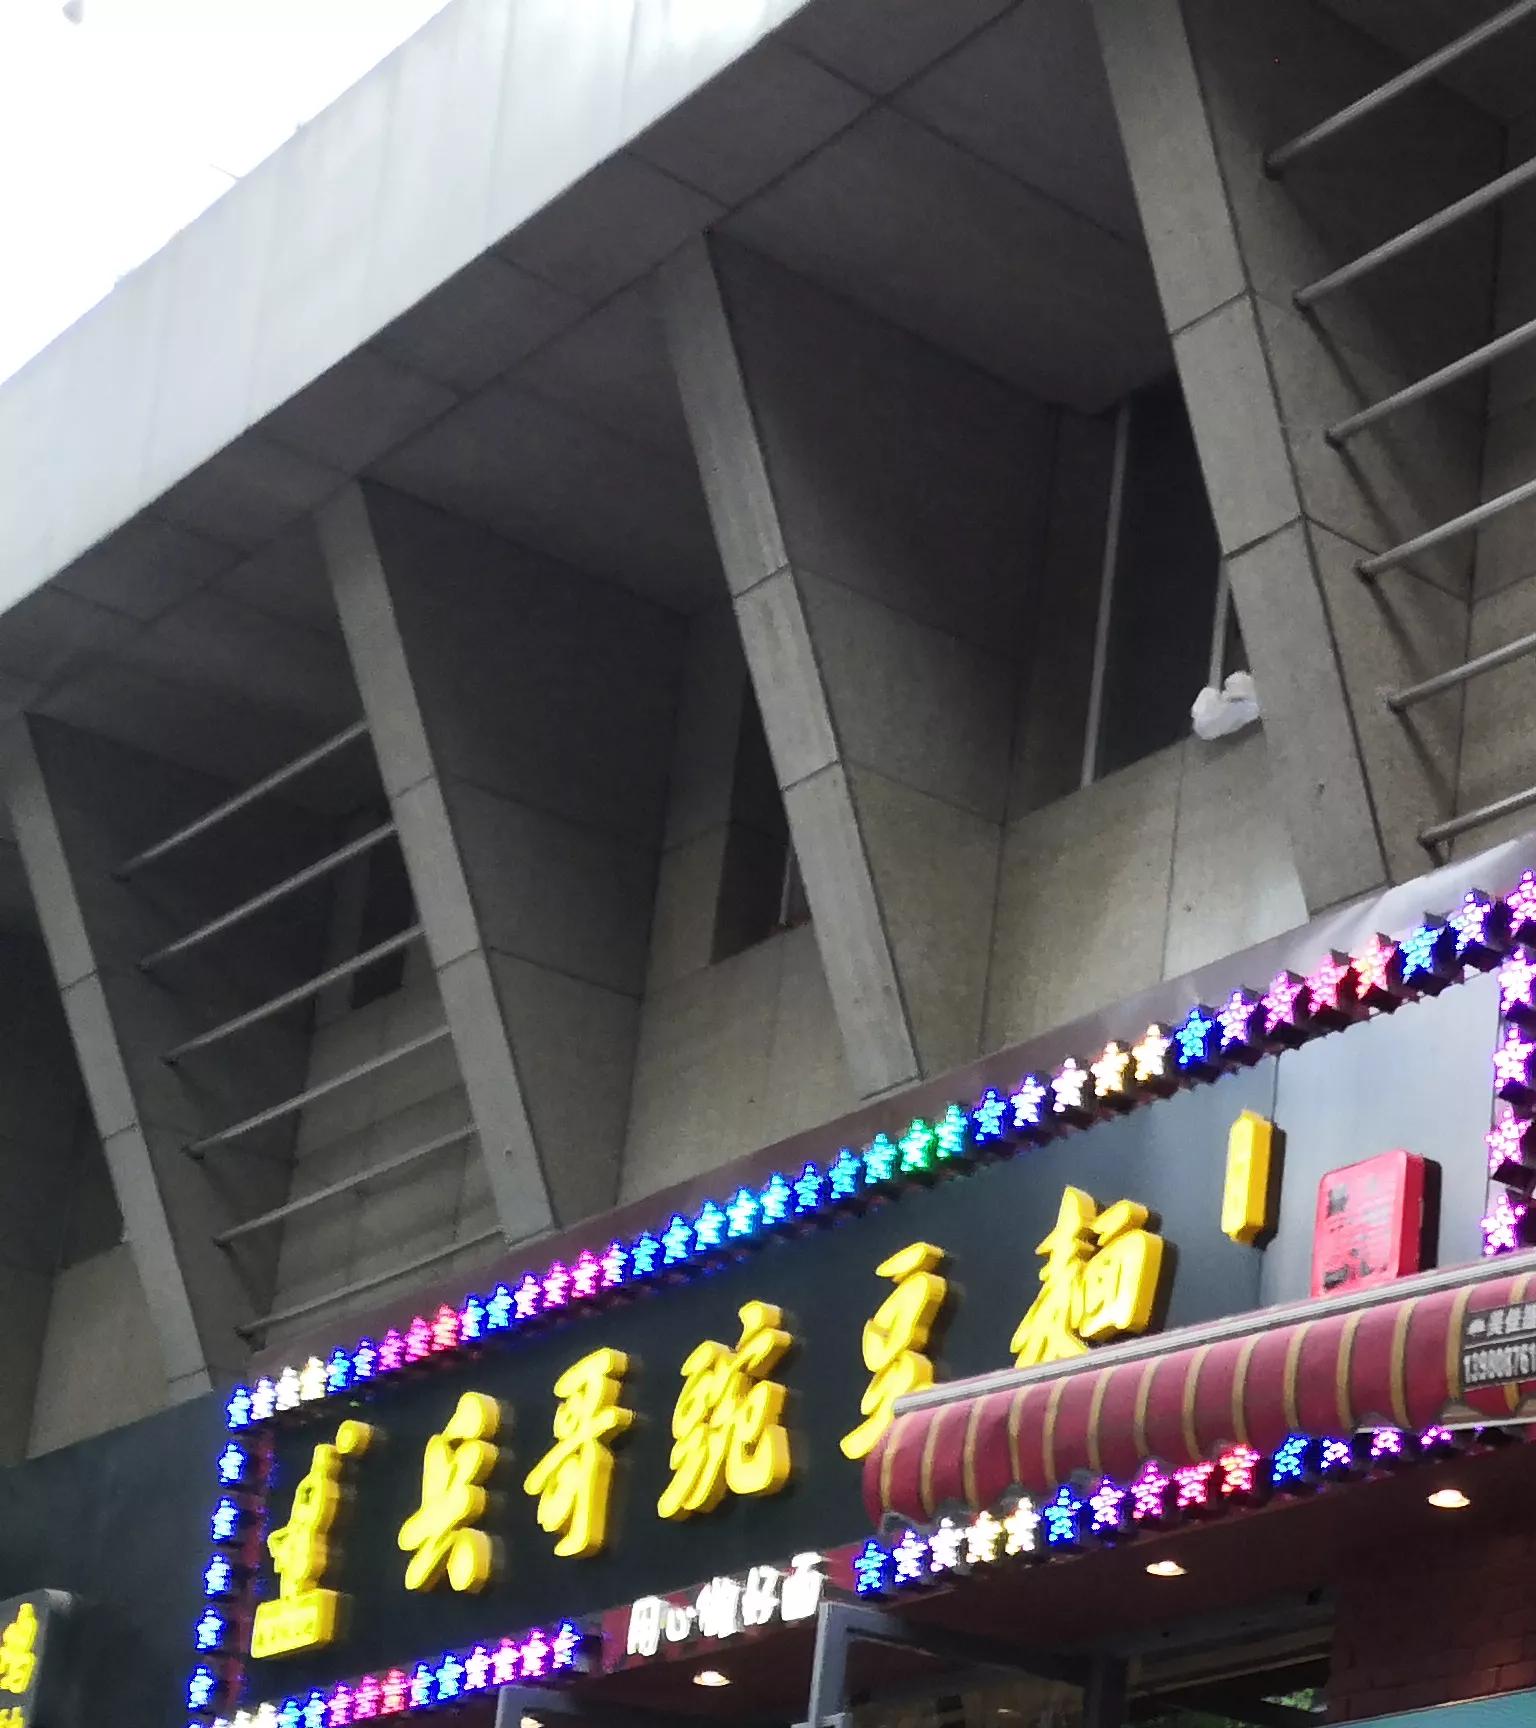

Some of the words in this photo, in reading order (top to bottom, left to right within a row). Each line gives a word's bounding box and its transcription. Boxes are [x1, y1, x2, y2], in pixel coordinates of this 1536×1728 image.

[627, 1552, 825, 1657] 用心做好面
